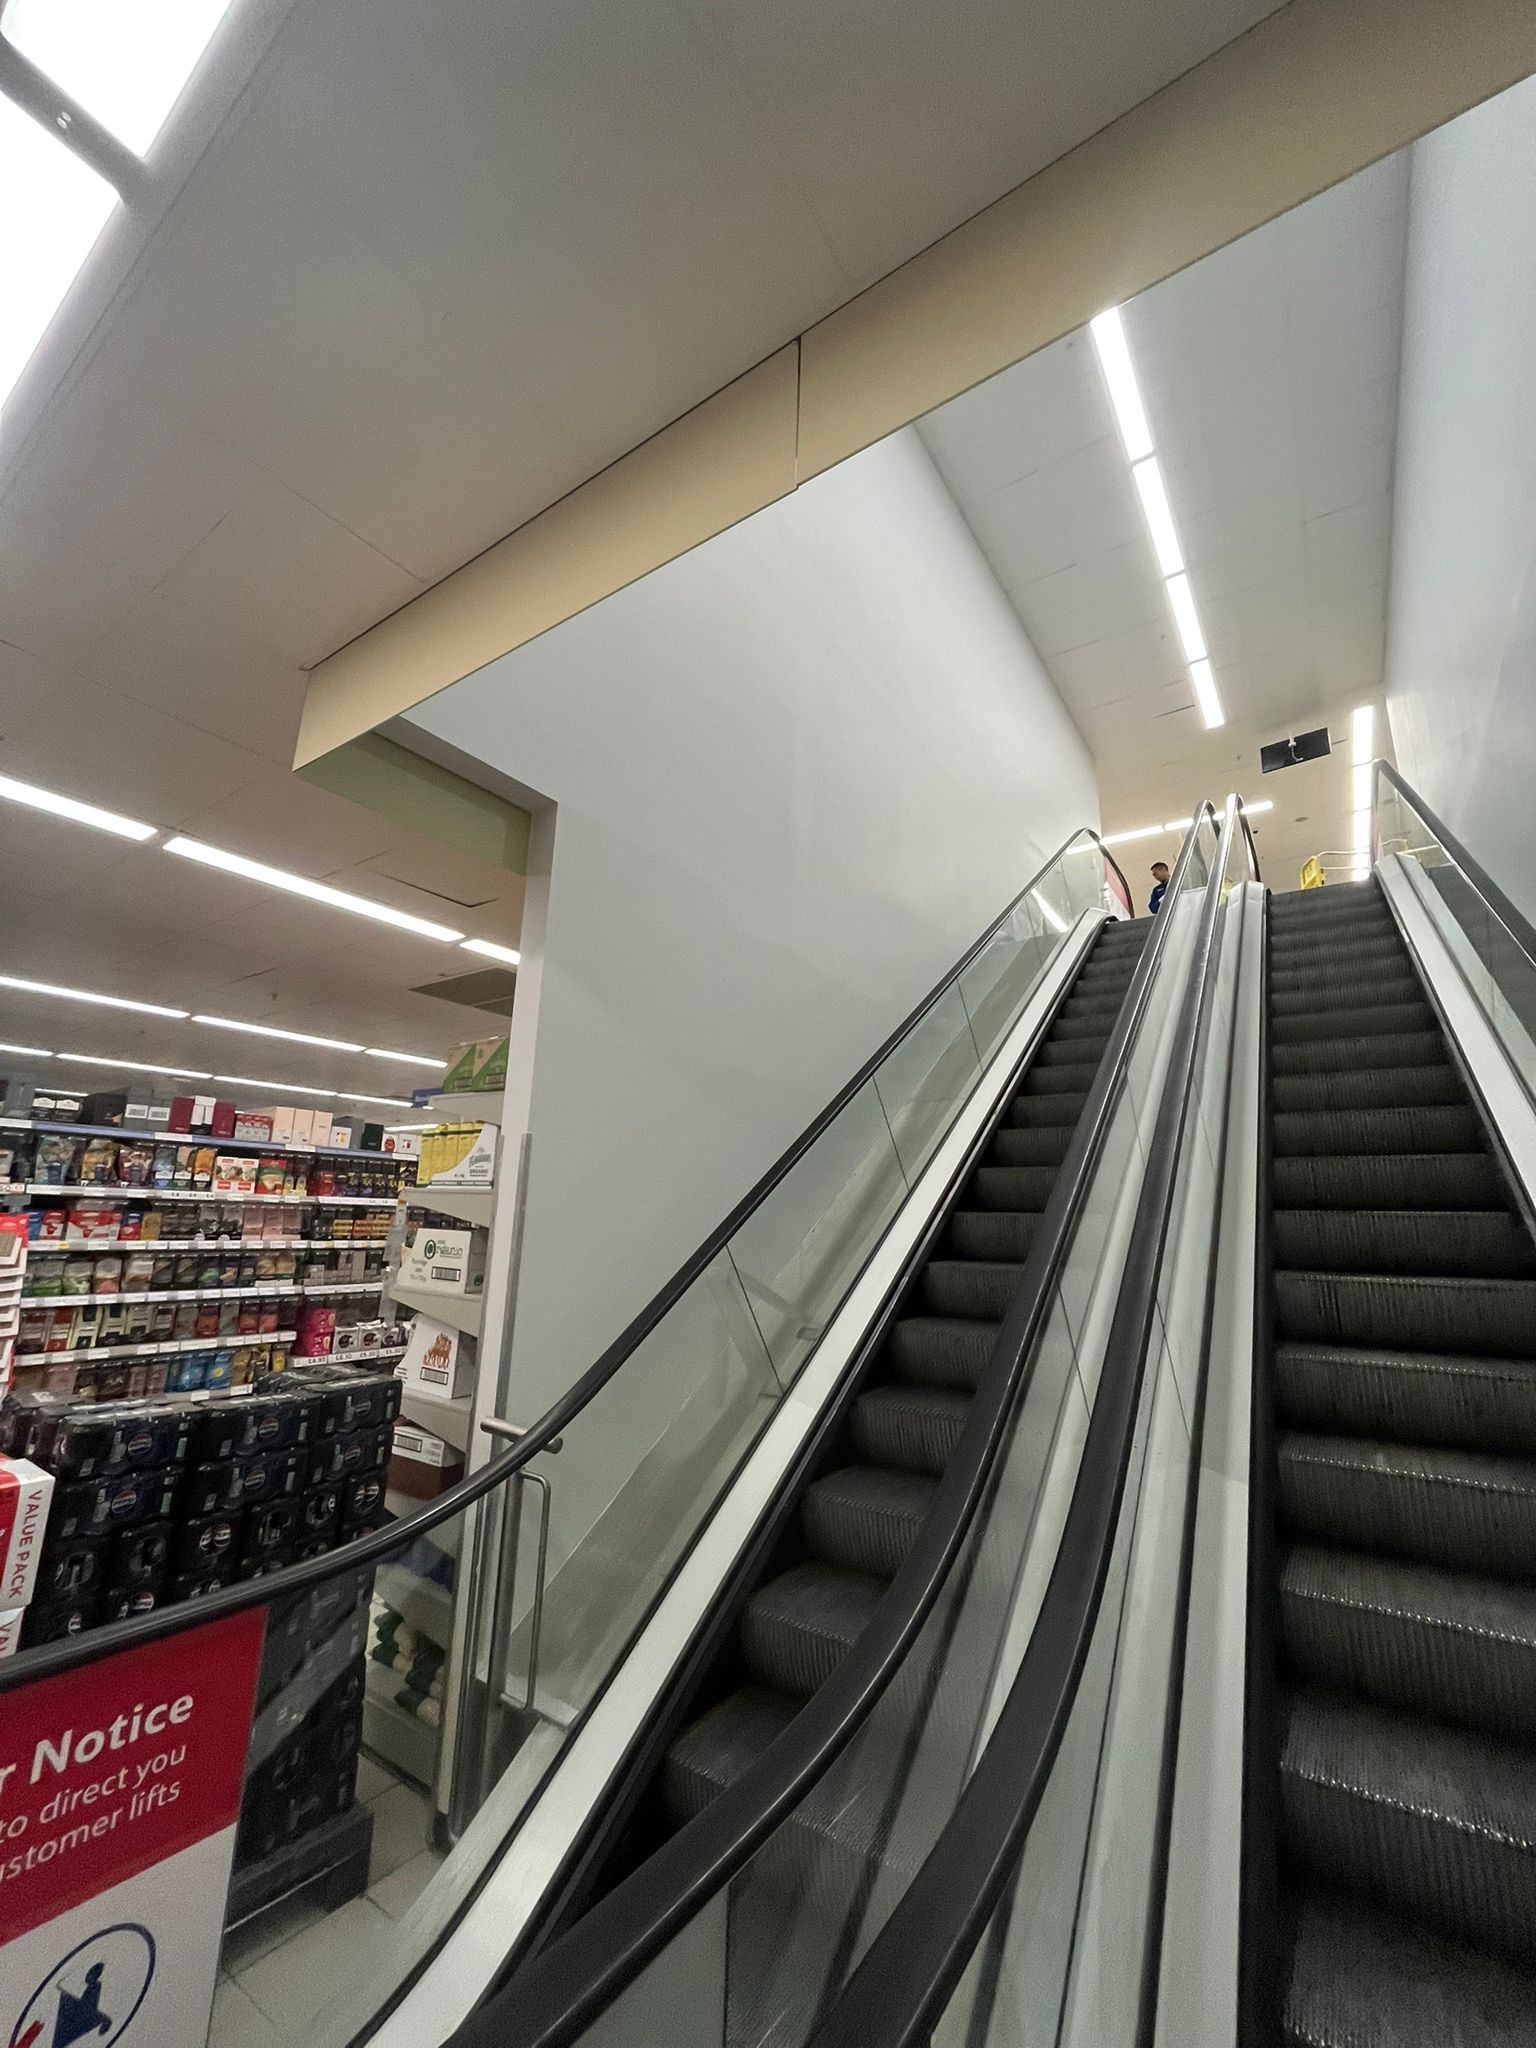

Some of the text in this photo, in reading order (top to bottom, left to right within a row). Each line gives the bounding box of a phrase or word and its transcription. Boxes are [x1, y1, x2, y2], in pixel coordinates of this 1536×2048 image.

[8, 1489, 42, 1599] VALUE PACK
[30, 1695, 194, 1785] Notice
[39, 1767, 129, 1824] direct
[132, 1745, 187, 1790] you
[0, 1781, 181, 1882] stomer lifts
